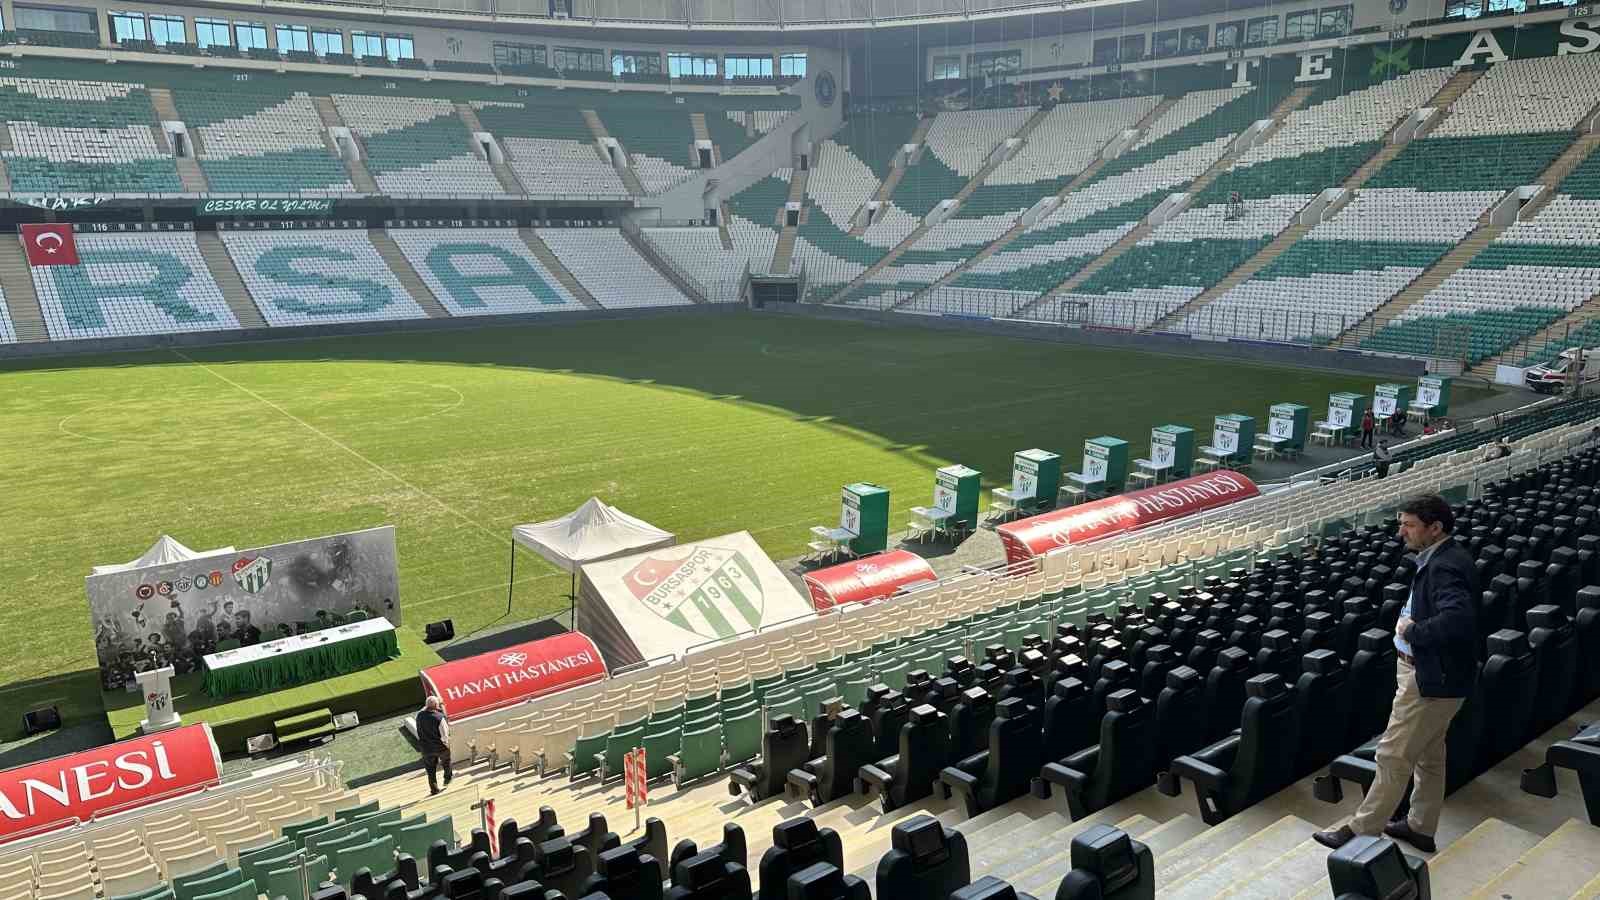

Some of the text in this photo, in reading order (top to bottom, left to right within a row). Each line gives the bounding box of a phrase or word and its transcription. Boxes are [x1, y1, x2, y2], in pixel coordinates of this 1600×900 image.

[1574, 6, 1588, 17] 125
[204, 199, 257, 212] CESUR
[260, 199, 278, 210] OL
[92, 223, 108, 231] 116
[646, 549, 713, 605] BURSASPOR
[697, 565, 742, 609] 1963
[445, 674, 502, 701] HAYAT
